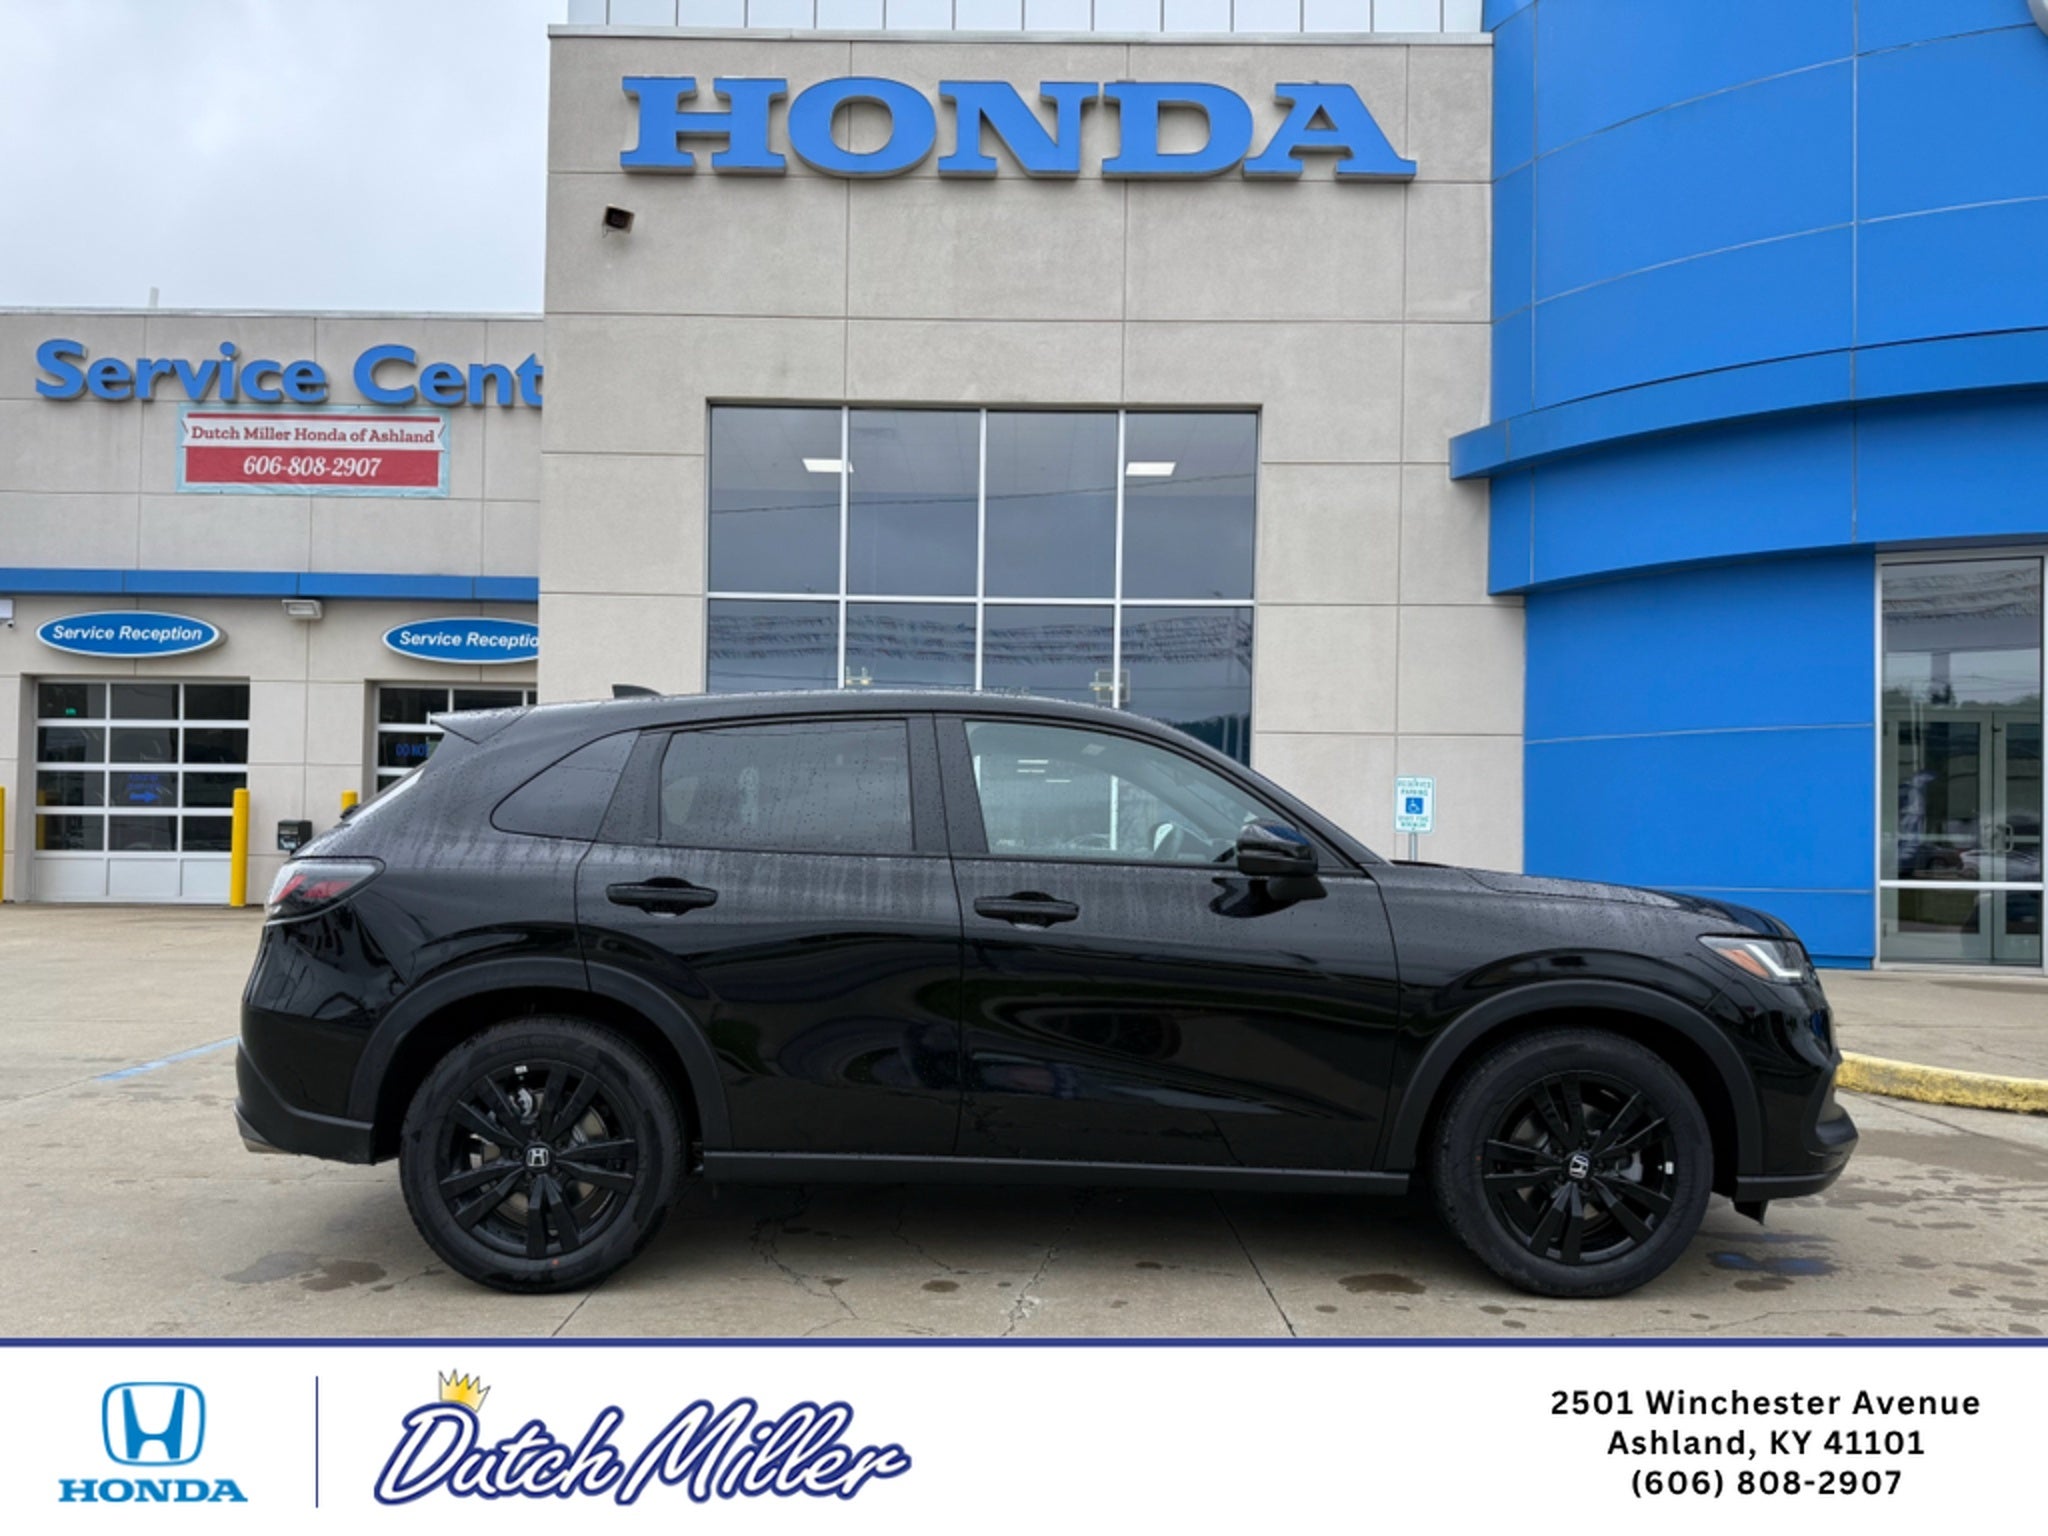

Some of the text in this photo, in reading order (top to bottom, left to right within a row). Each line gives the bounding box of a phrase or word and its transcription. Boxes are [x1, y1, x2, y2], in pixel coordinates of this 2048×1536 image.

[620, 77, 1417, 180] HONDA
[35, 339, 543, 407] Service Cent
[191, 425, 435, 443] Dutch Miller Honda of Ashland
[243, 455, 382, 477] 606-808-2907
[52, 624, 203, 643] Service Reception
[400, 631, 462, 646] Service
